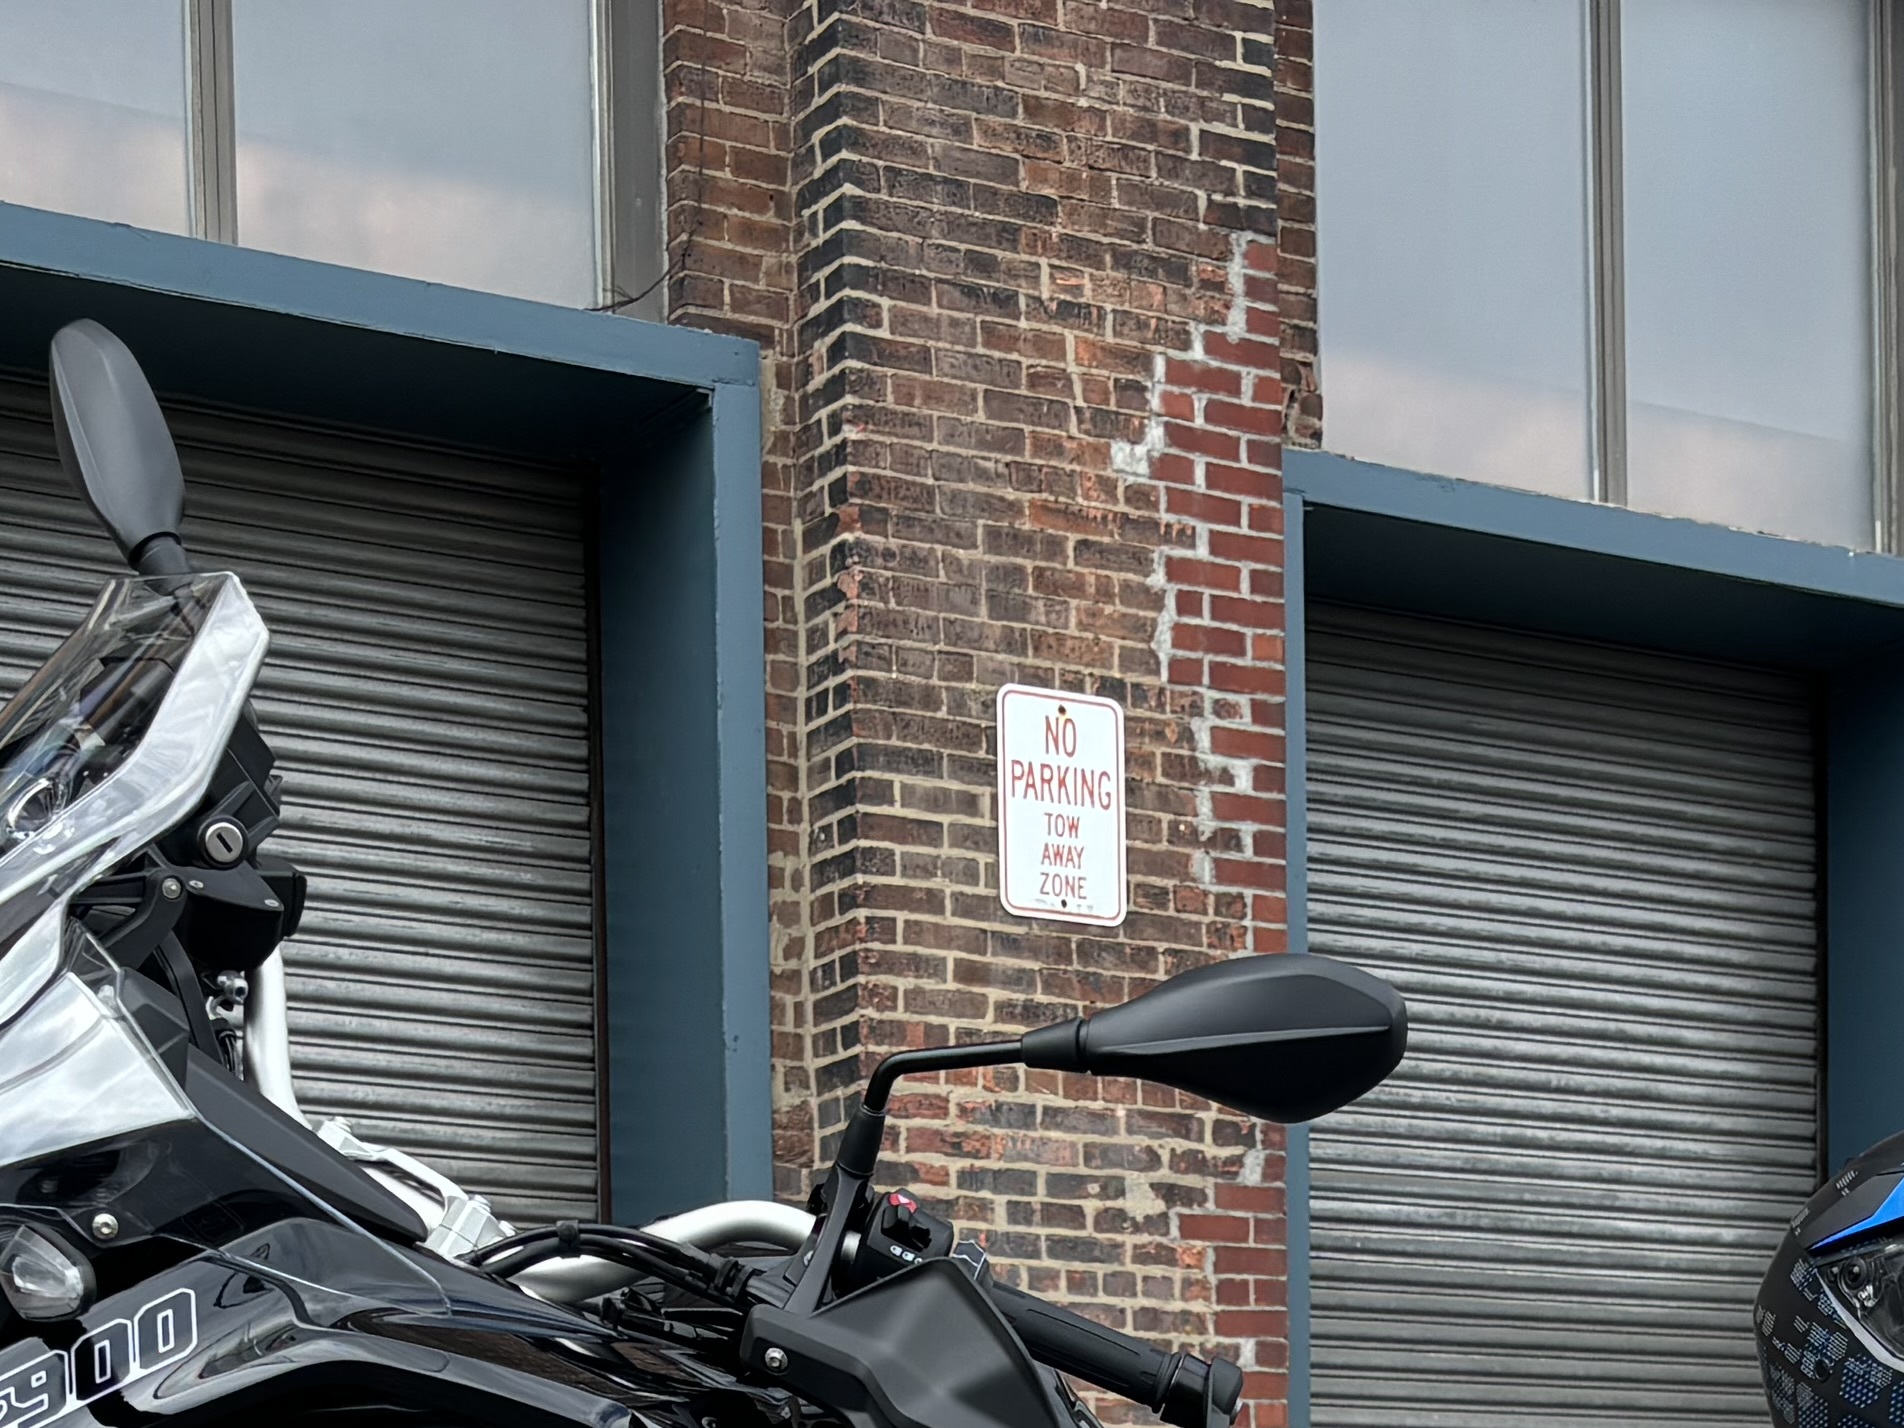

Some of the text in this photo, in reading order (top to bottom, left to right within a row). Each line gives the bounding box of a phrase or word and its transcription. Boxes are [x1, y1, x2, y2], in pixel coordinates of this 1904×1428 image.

[1044, 715, 1077, 758] NO
[1010, 759, 1112, 811] PARKING
[1043, 812, 1081, 839] TOW
[1040, 842, 1085, 870] AWAY
[1039, 871, 1088, 900] ZONE
